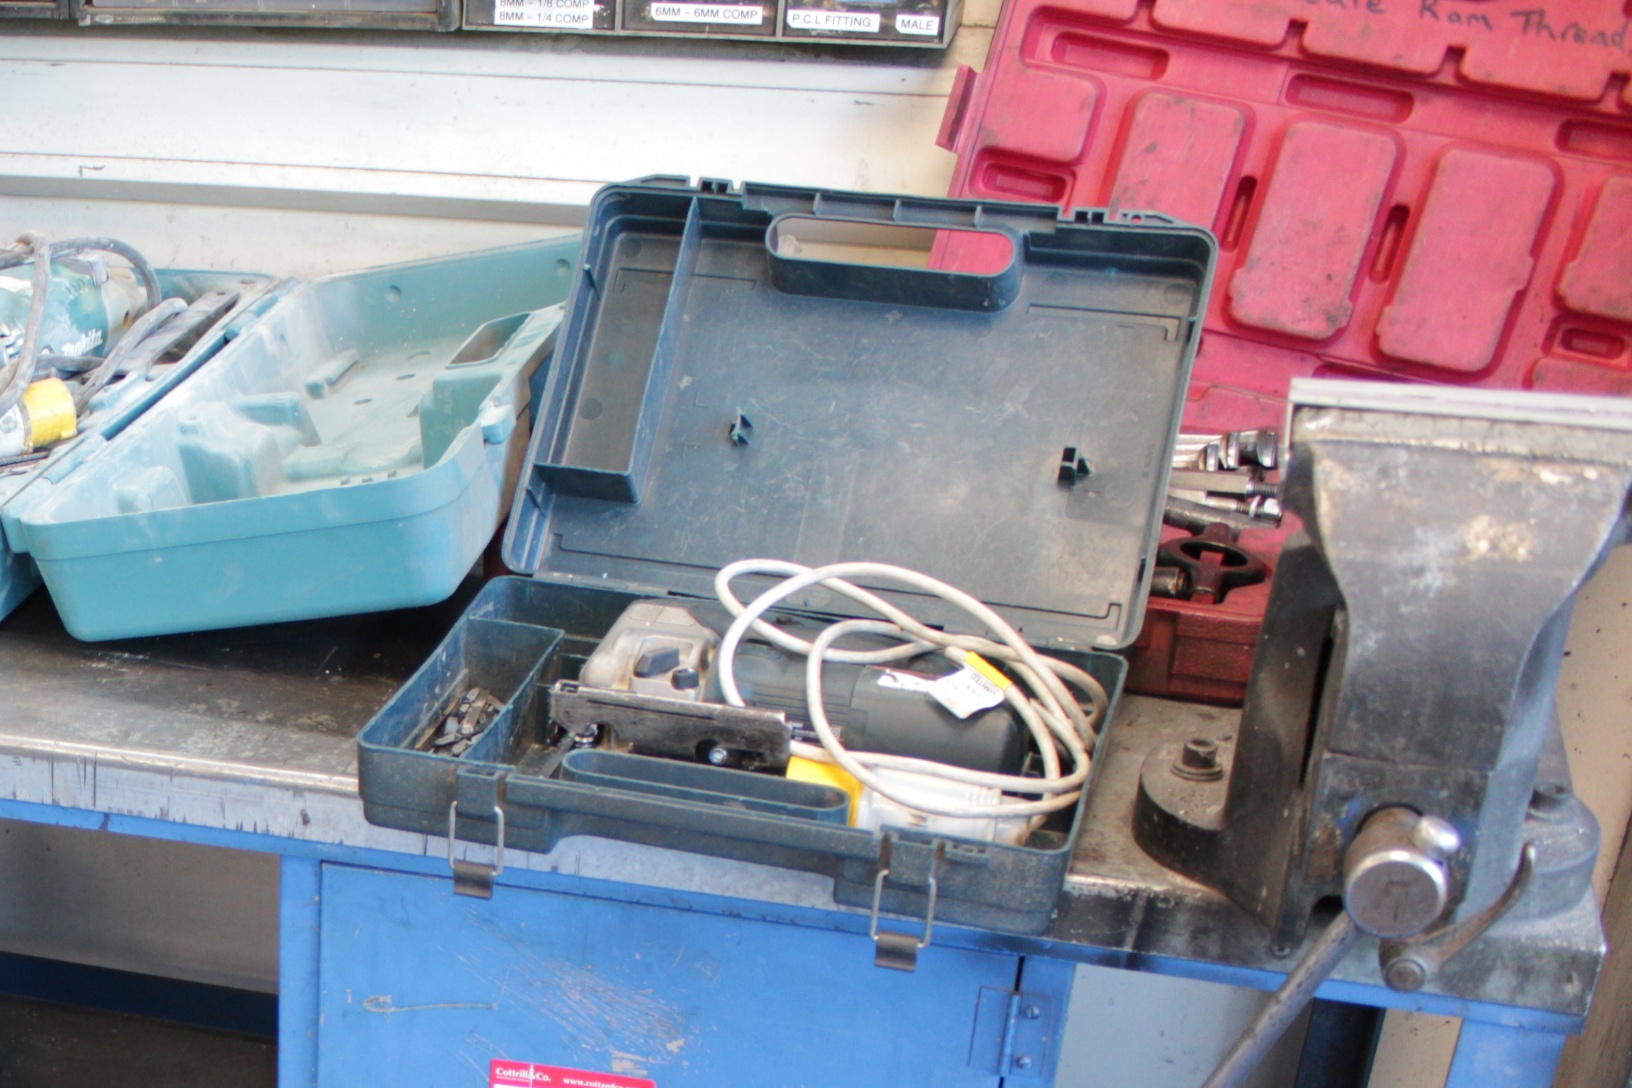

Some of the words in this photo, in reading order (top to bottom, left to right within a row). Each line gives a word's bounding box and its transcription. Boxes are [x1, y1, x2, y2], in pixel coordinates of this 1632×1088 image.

[556, 0, 590, 9] COMP
[499, 11, 524, 21] 8MM
[537, 13, 552, 22] 1/4
[555, 14, 589, 24] COMP
[655, 7, 681, 17] 6MM
[694, 8, 719, 18] 6MM
[723, 9, 758, 20] COMP
[792, 13, 821, 25] P.C.L
[825, 15, 871, 28] FITTING
[900, 18, 934, 31] MALE
